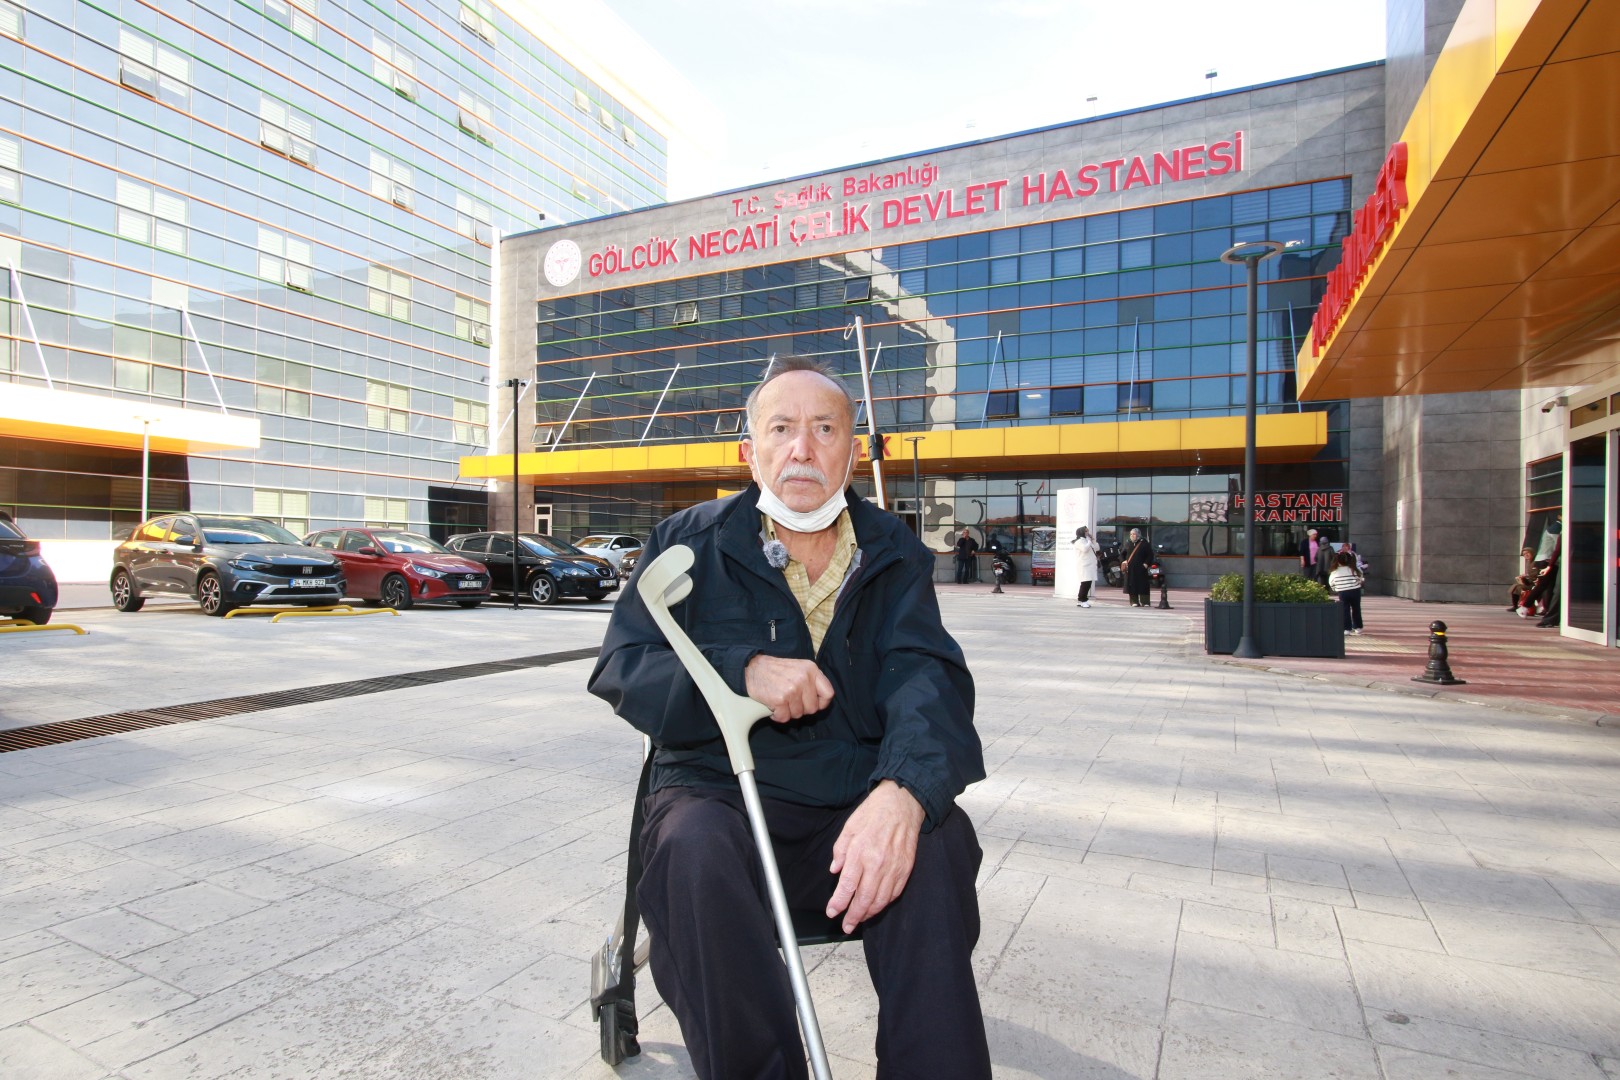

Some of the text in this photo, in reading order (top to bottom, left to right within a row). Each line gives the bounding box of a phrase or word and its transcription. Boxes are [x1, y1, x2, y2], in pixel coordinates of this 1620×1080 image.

[588, 130, 1244, 279] GÖLCÜK NECATİ ÇELİK DEVLET HASTANESİ
[731, 195, 765, 217] T.C.
[842, 162, 940, 197] Bakanlığı
[1234, 493, 1343, 508] HASTANE
[1254, 506, 1342, 522] KANTİNİ
